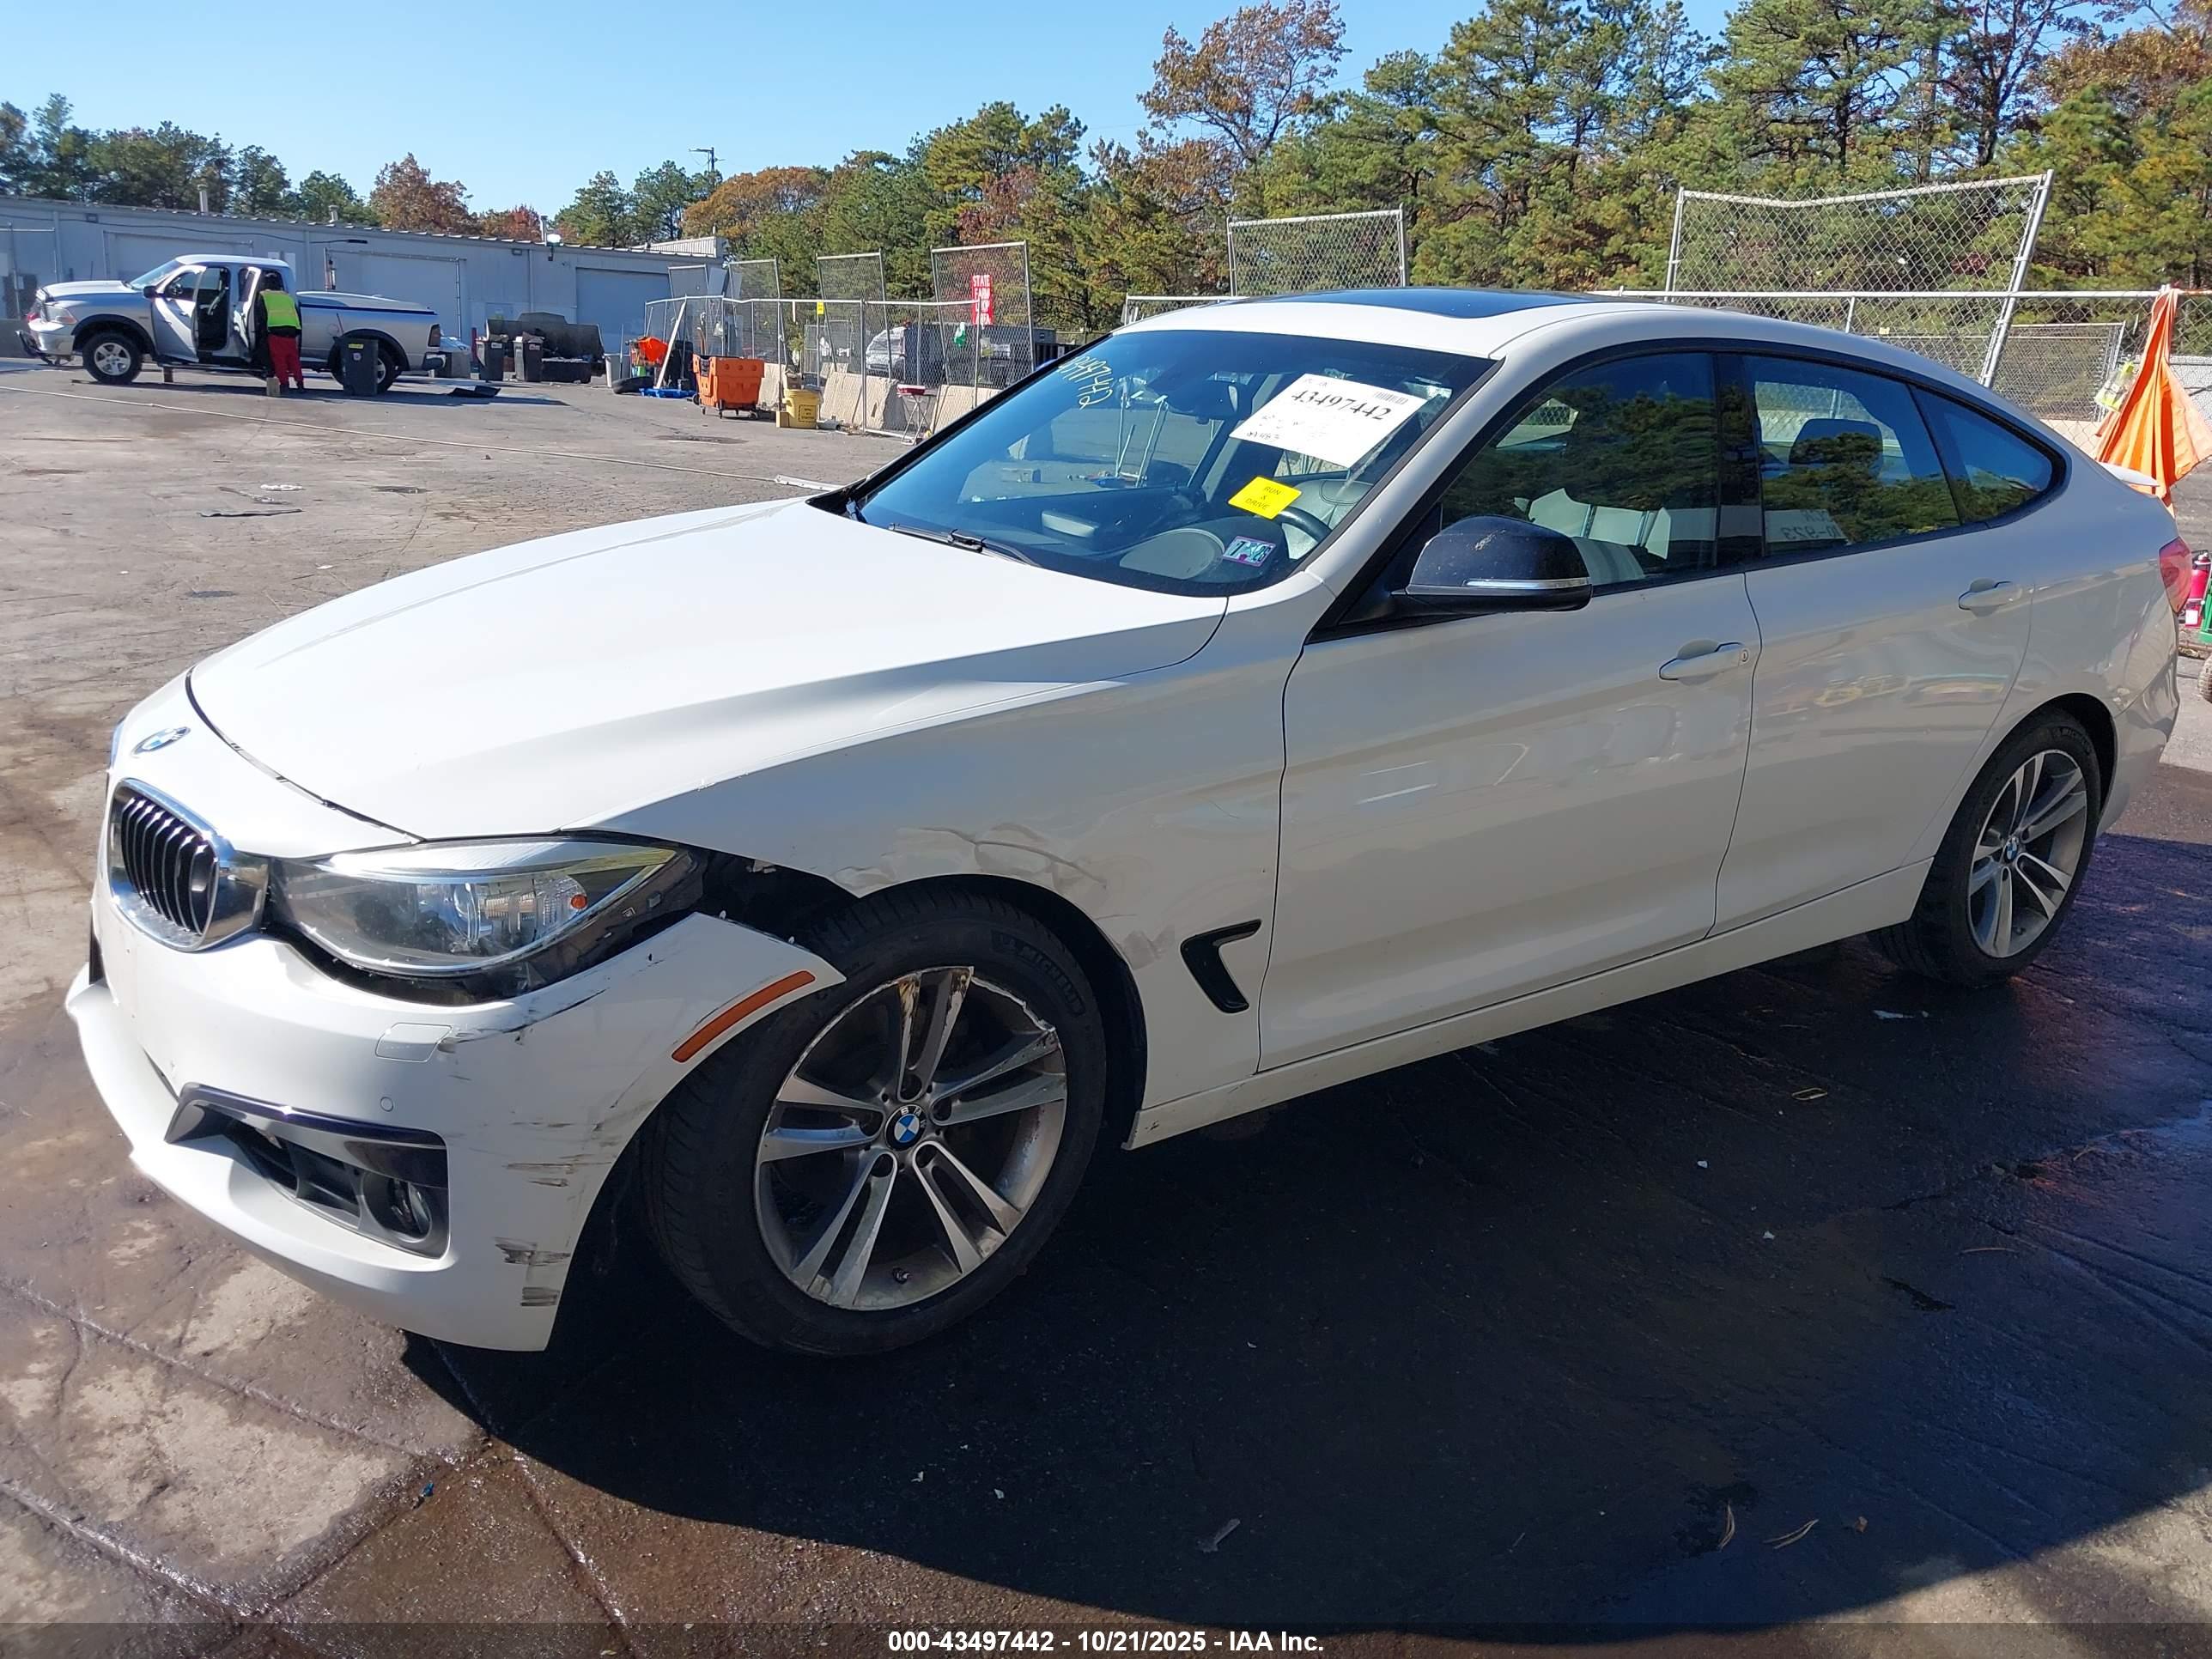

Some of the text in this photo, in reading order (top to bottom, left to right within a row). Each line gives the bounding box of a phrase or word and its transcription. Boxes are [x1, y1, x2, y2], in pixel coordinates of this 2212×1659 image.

[972, 274, 991, 287] STATE
[974, 287, 991, 300] FARM
[1291, 390, 1392, 420] 43497442
[1263, 486, 1281, 495] RUN
[1244, 497, 1270, 510] DRIVE
